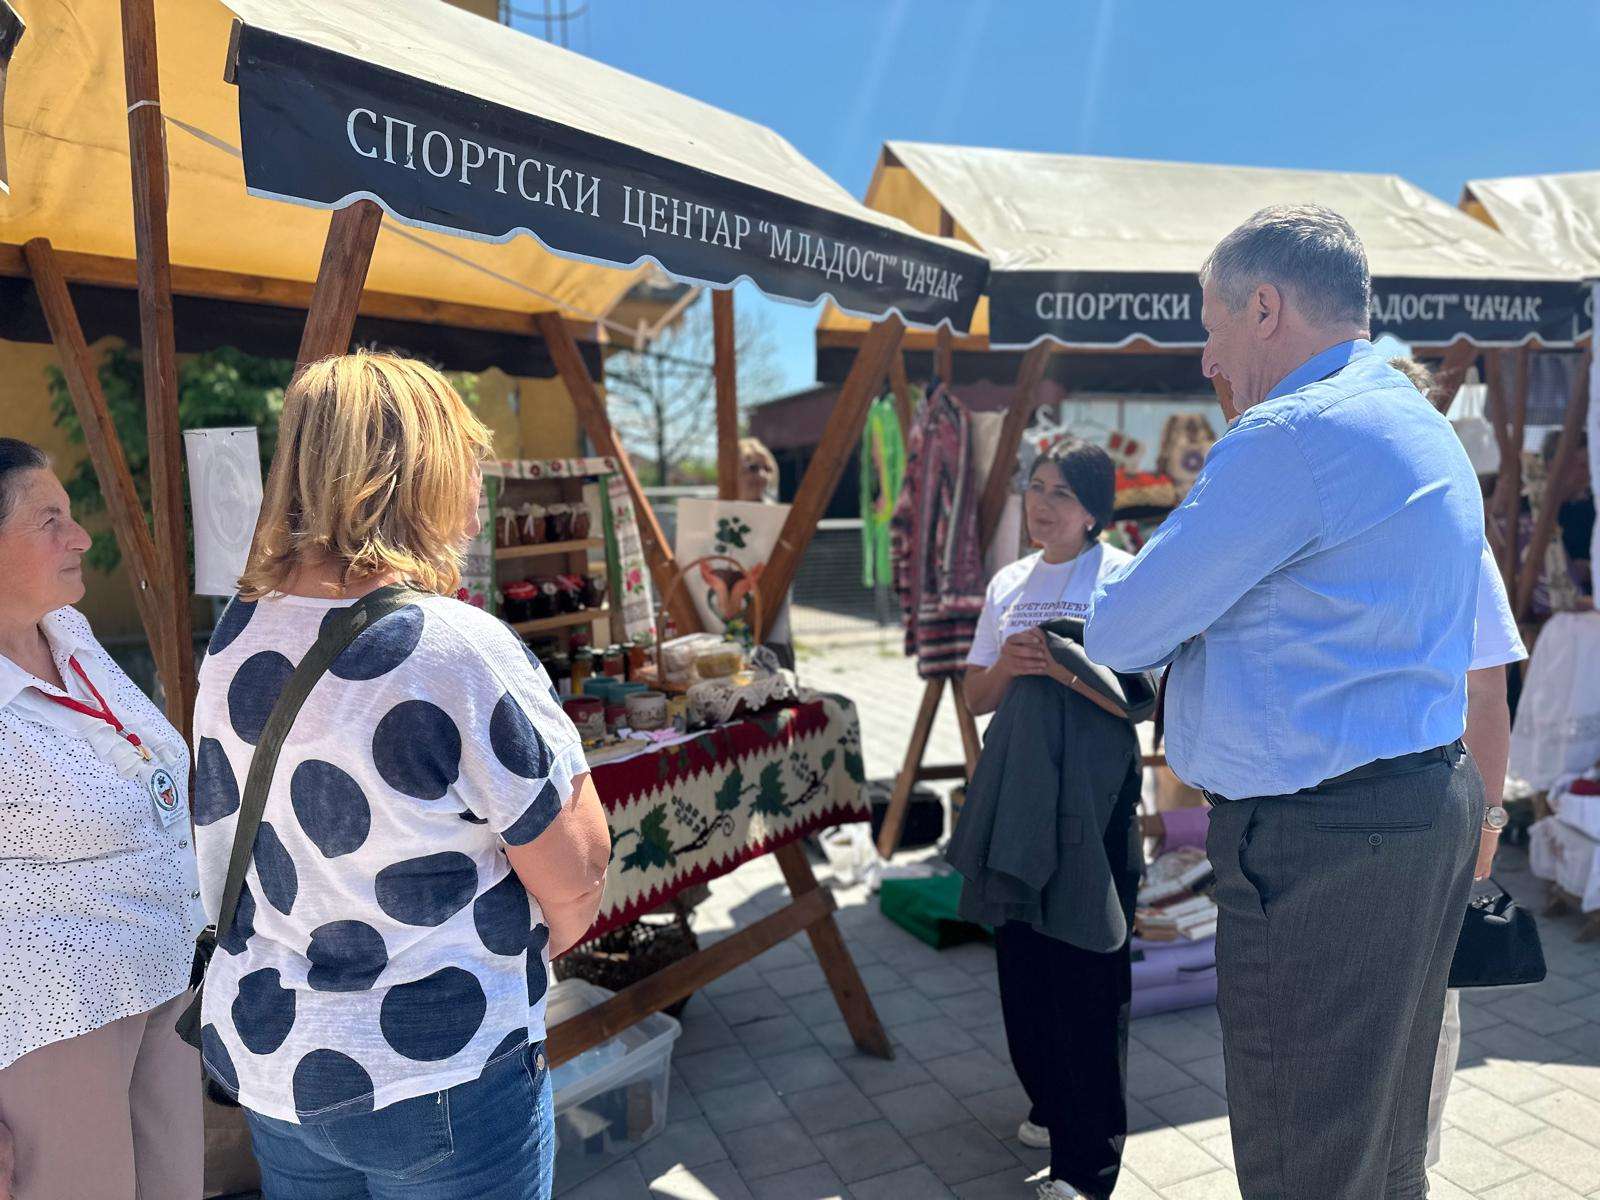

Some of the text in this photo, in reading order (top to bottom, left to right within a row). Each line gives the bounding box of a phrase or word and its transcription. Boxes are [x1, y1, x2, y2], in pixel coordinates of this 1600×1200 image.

[346, 108, 601, 218] СПОРТСКИ
[622, 185, 751, 251] ЦЕНТАР
[901, 263, 963, 302] ЧАЧАК
[1035, 291, 1191, 321] СПОРТСКИ
[1463, 295, 1542, 322] ЧАЧАК
